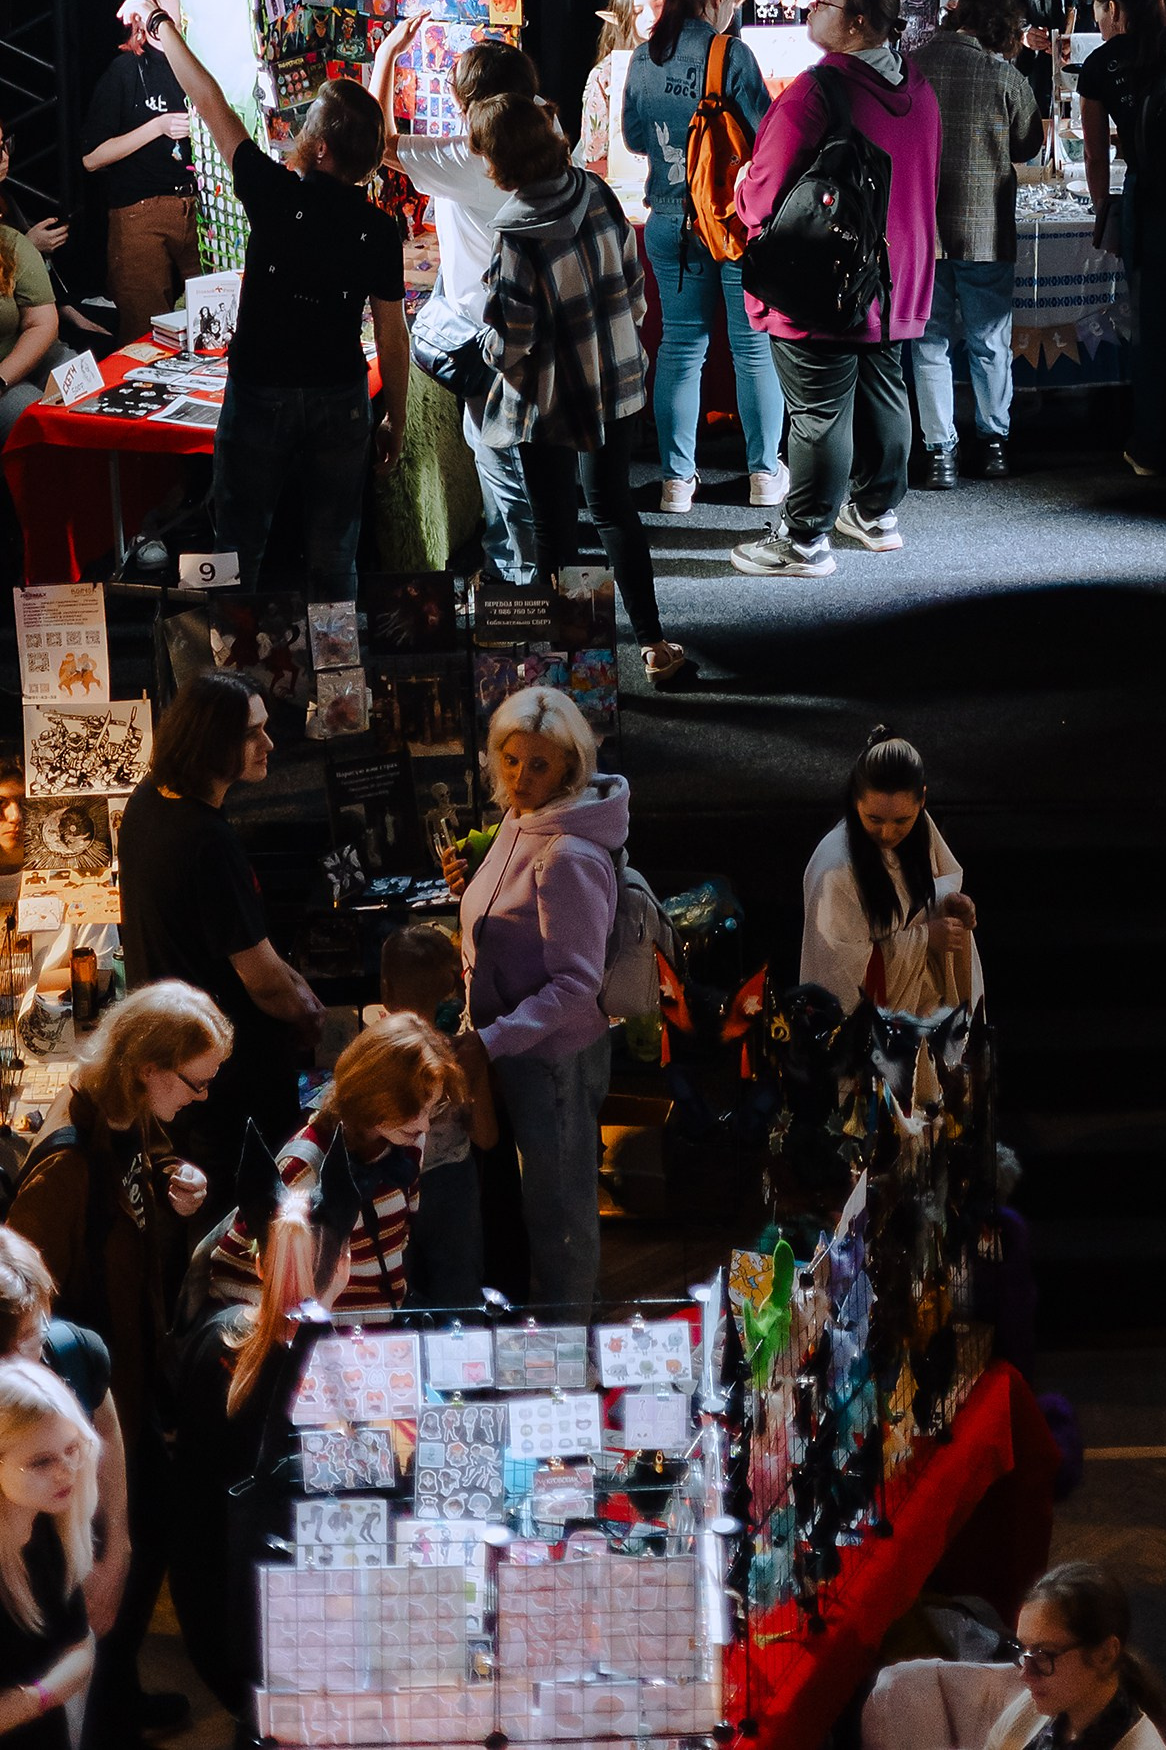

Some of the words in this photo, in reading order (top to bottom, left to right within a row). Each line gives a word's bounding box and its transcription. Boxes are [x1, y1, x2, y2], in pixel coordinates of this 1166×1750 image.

[295, 210, 303, 220] D
[360, 232, 368, 242] K
[268, 265, 276, 274] R
[342, 291, 349, 300] T
[199, 562, 215, 581] 9
